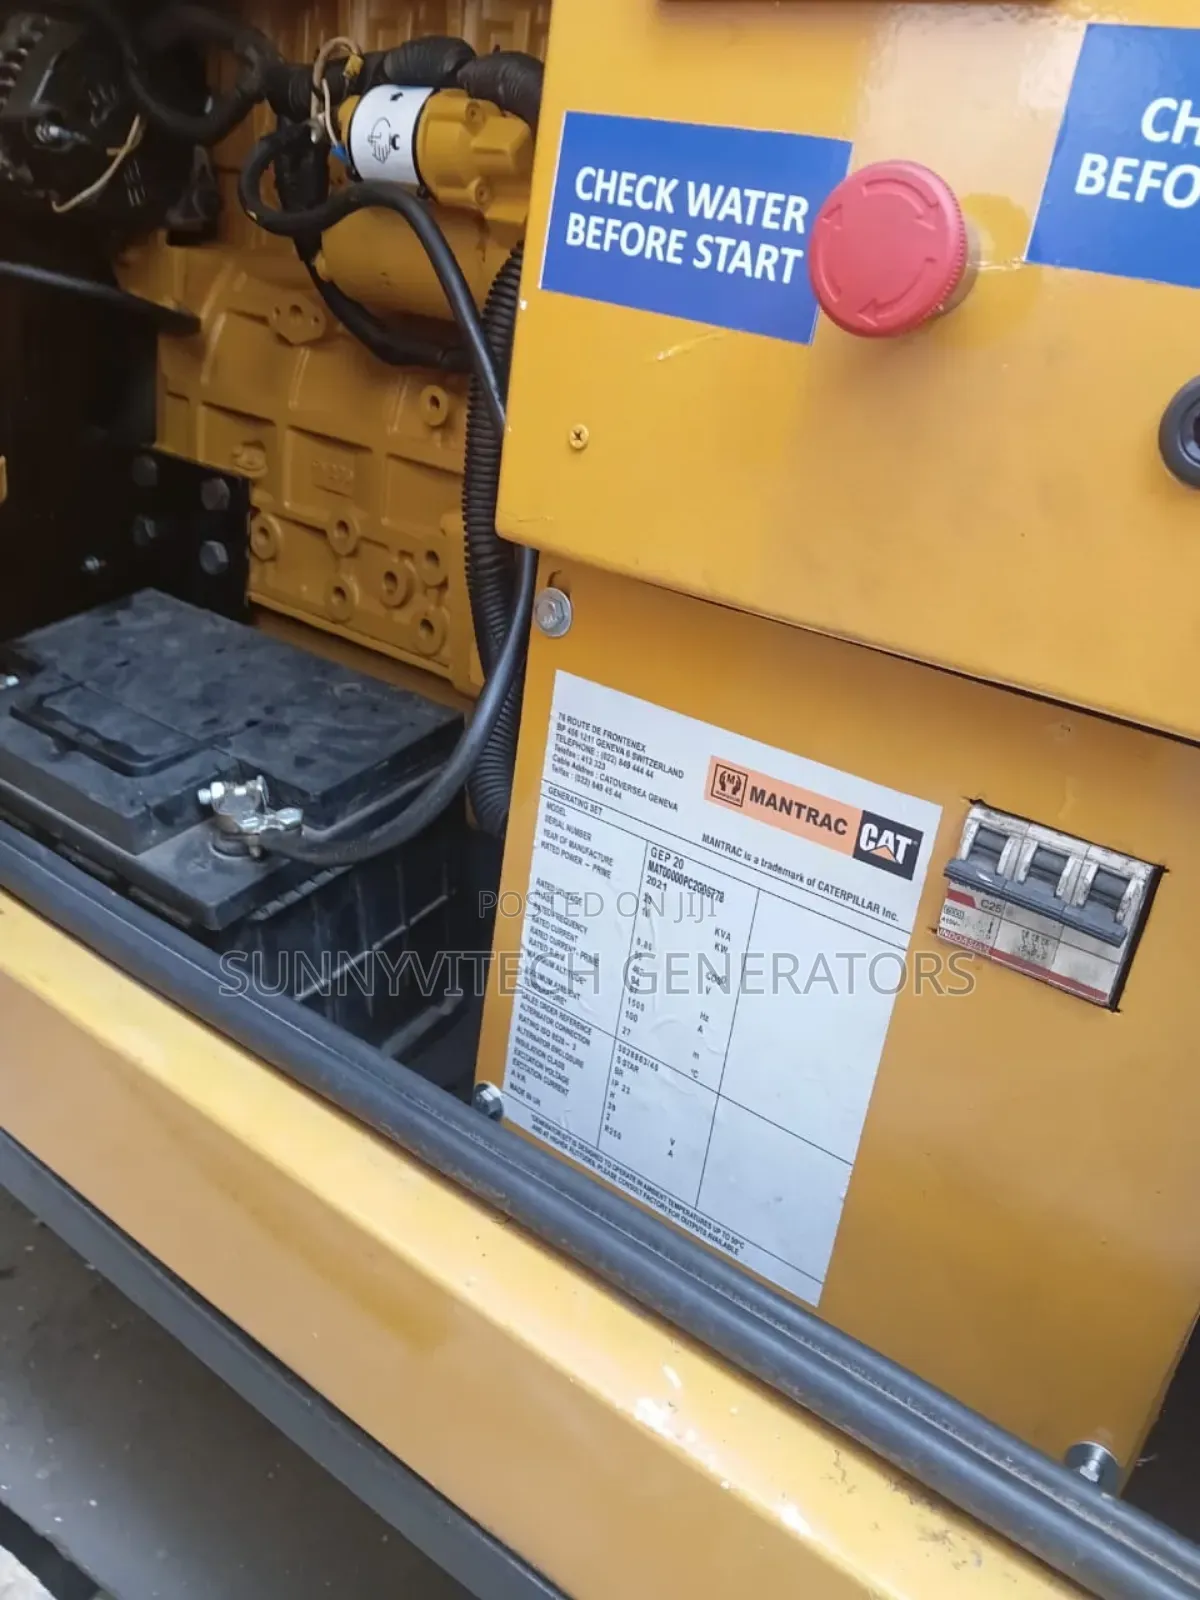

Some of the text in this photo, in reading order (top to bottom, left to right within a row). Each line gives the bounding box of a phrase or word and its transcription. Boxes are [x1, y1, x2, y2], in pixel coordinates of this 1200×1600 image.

[1141, 97, 1200, 147] CH
[1074, 152, 1200, 209] BEFO
[575, 166, 809, 234] CHECK WATER
[566, 212, 804, 284] BEFORE START
[556, 733, 595, 756] TELEPHONE
[567, 715, 590, 732] ROUTE
[591, 725, 601, 736] DE
[603, 729, 646, 754] FRONTENEX
[596, 737, 625, 756] GENEVA
[632, 752, 685, 780] SWITZERLAND
[548, 786, 603, 817] GENERATING SET
[599, 772, 646, 799] CATOVERSEA
[648, 792, 679, 813] GENEVA
[546, 801, 566, 817] MODEL
[750, 786, 848, 836] MANTRAC
[544, 814, 592, 842] SERIAL NUMBER
[543, 828, 614, 867] YEAR OF MANUFACTURE
[650, 846, 685, 871] GEP 20
[859, 823, 912, 865] CAT
[541, 840, 612, 879] RATED POWER PRIME
[536, 877, 556, 894] RATED
[646, 874, 667, 892] 2021
[701, 833, 899, 922] MANTRAC is a trademark of CATERPILLAR Inc.
[981, 899, 1001, 914] C25
[530, 925, 549, 941] RATED
[549, 935, 576, 955] CURRENT
[531, 914, 578, 944] RATED CURRENT
[714, 927, 732, 943] KVA
[529, 936, 548, 953] RATED
[714, 942, 729, 956] KW
[520, 1001, 591, 1047] ALTERNATOR CONNECTION
[559, 1011, 592, 1036] REFERENCE
[697, 1024, 704, 1034] A
[700, 1011, 710, 1023] Hz
[517, 1025, 584, 1069] ALTERNATOR ENCLOSURE
[543, 1076, 569, 1097] CURRENT
[667, 1148, 674, 1158] A
[597, 1163, 617, 1181] PLEASE
[618, 1176, 642, 1196] CONSULT
[643, 1191, 667, 1212] FACTORY
[669, 1207, 681, 1220] FOR
[681, 1215, 707, 1236] OUTPUTS
[605, 1159, 611, 1169] TO
[612, 1163, 636, 1184] OPERATE
[668, 1197, 713, 1230] TEMPERATURES
[712, 1225, 721, 1236] UP
[722, 1230, 730, 1241] TO
